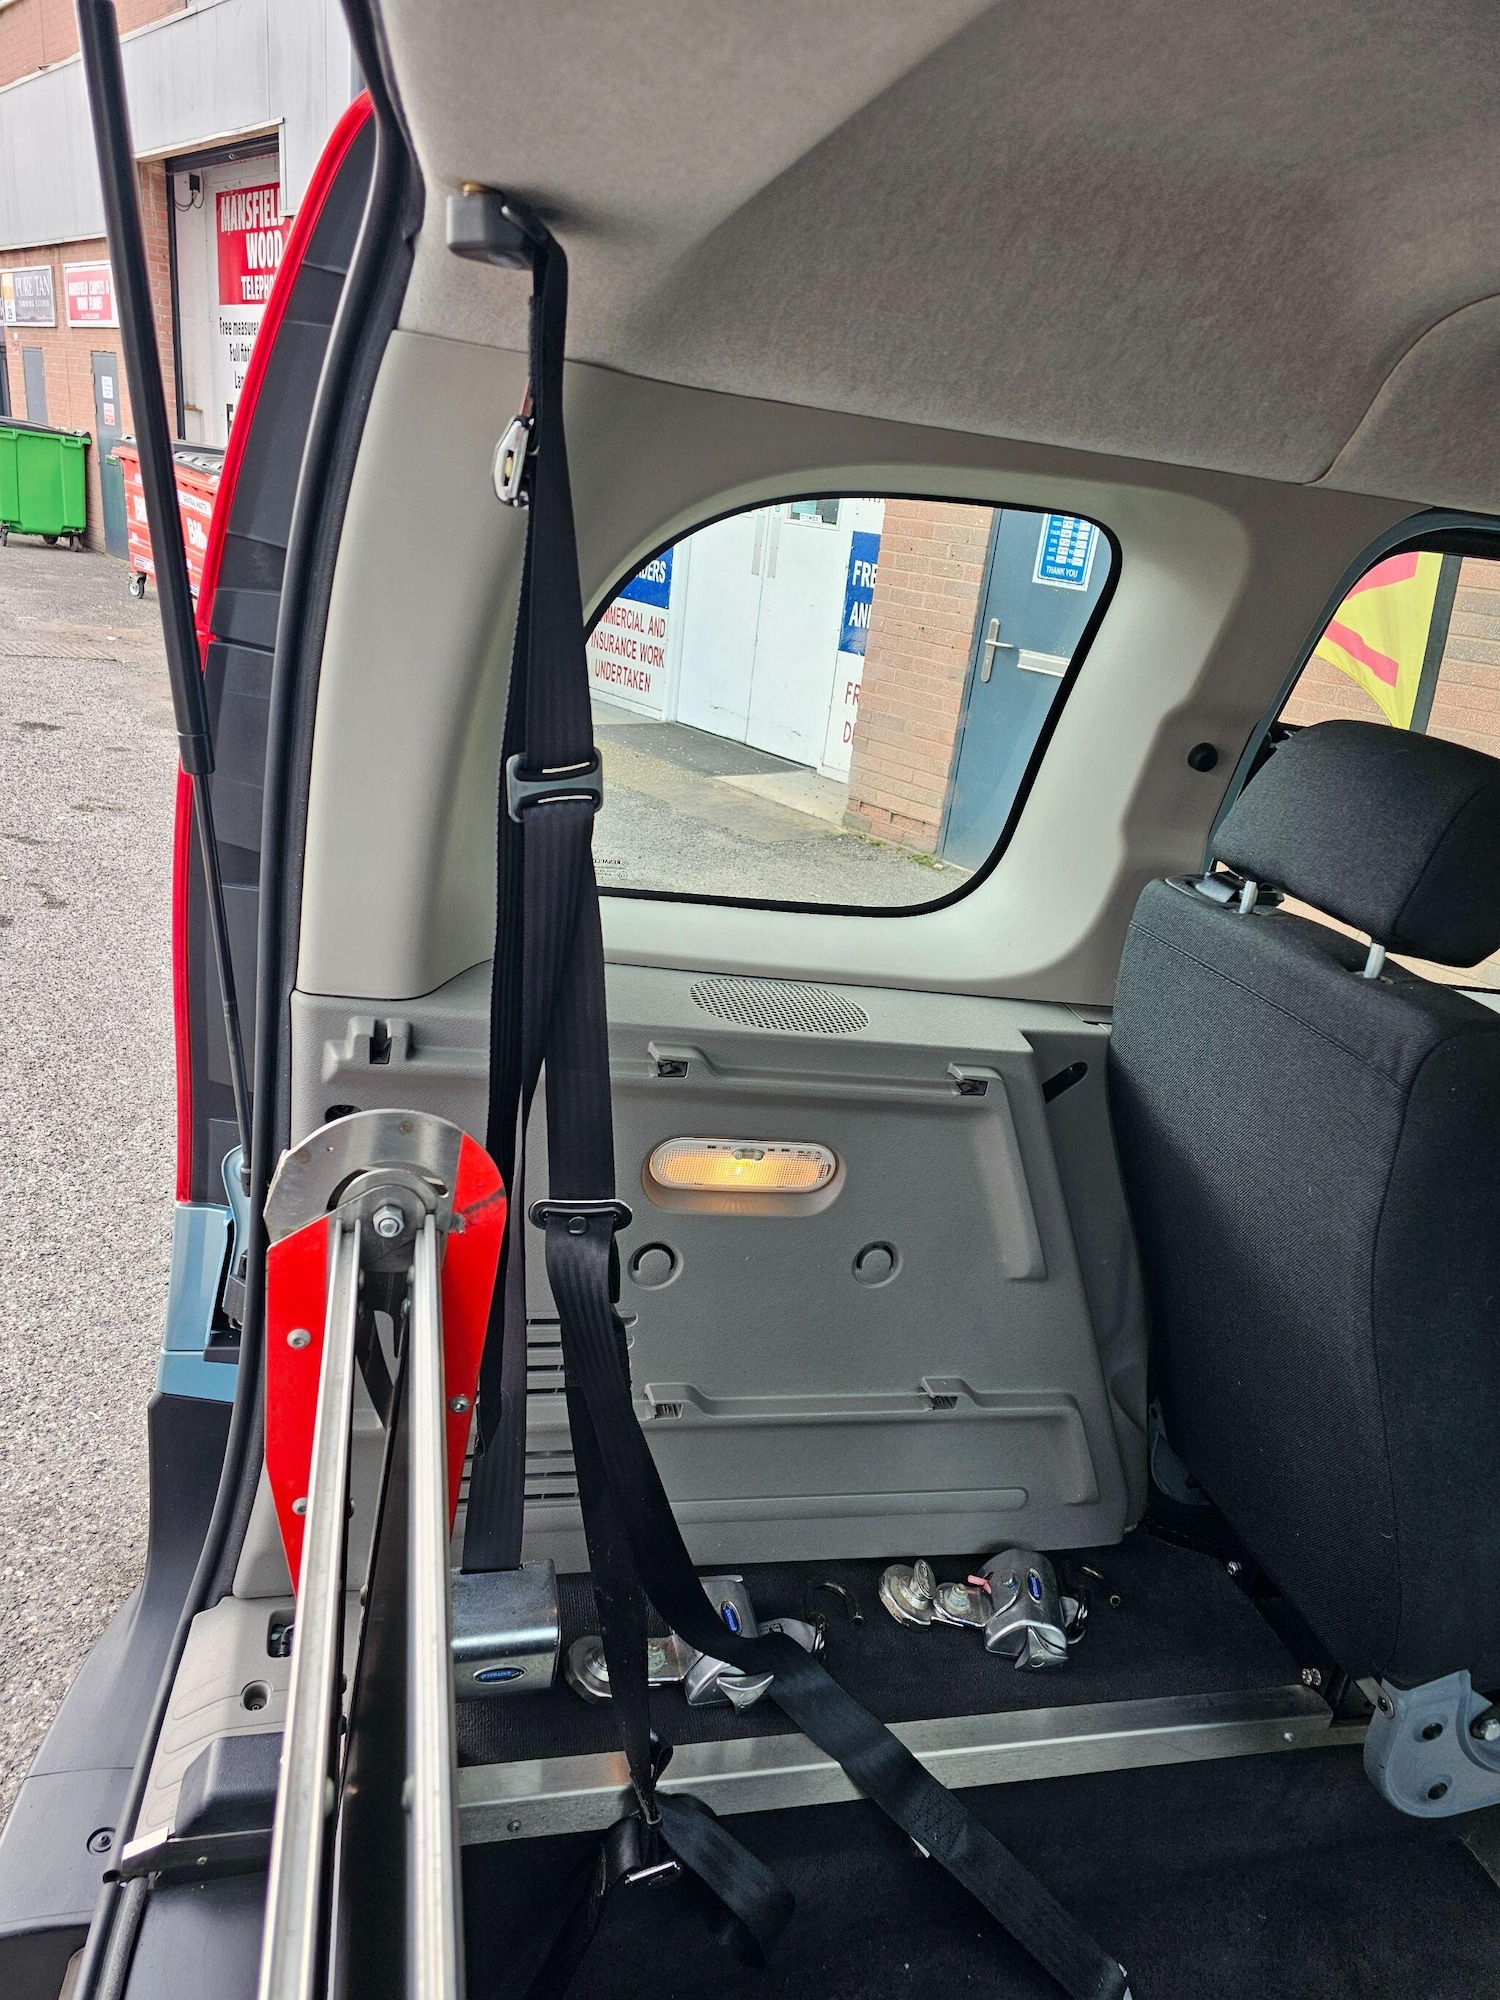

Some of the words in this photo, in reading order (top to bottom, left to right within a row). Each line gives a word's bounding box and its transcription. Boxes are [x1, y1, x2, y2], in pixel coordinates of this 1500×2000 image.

[246, 230, 283, 269] WOOD
[15, 276, 33, 297] PURE
[34, 275, 50, 296] TAN
[1046, 565, 1065, 576] THANK
[1065, 567, 1079, 578] YOU
[647, 615, 666, 638] AND
[591, 630, 637, 660] INSURANCE
[640, 642, 665, 668] WORK
[594, 658, 652, 693] UNDERTAKEN
